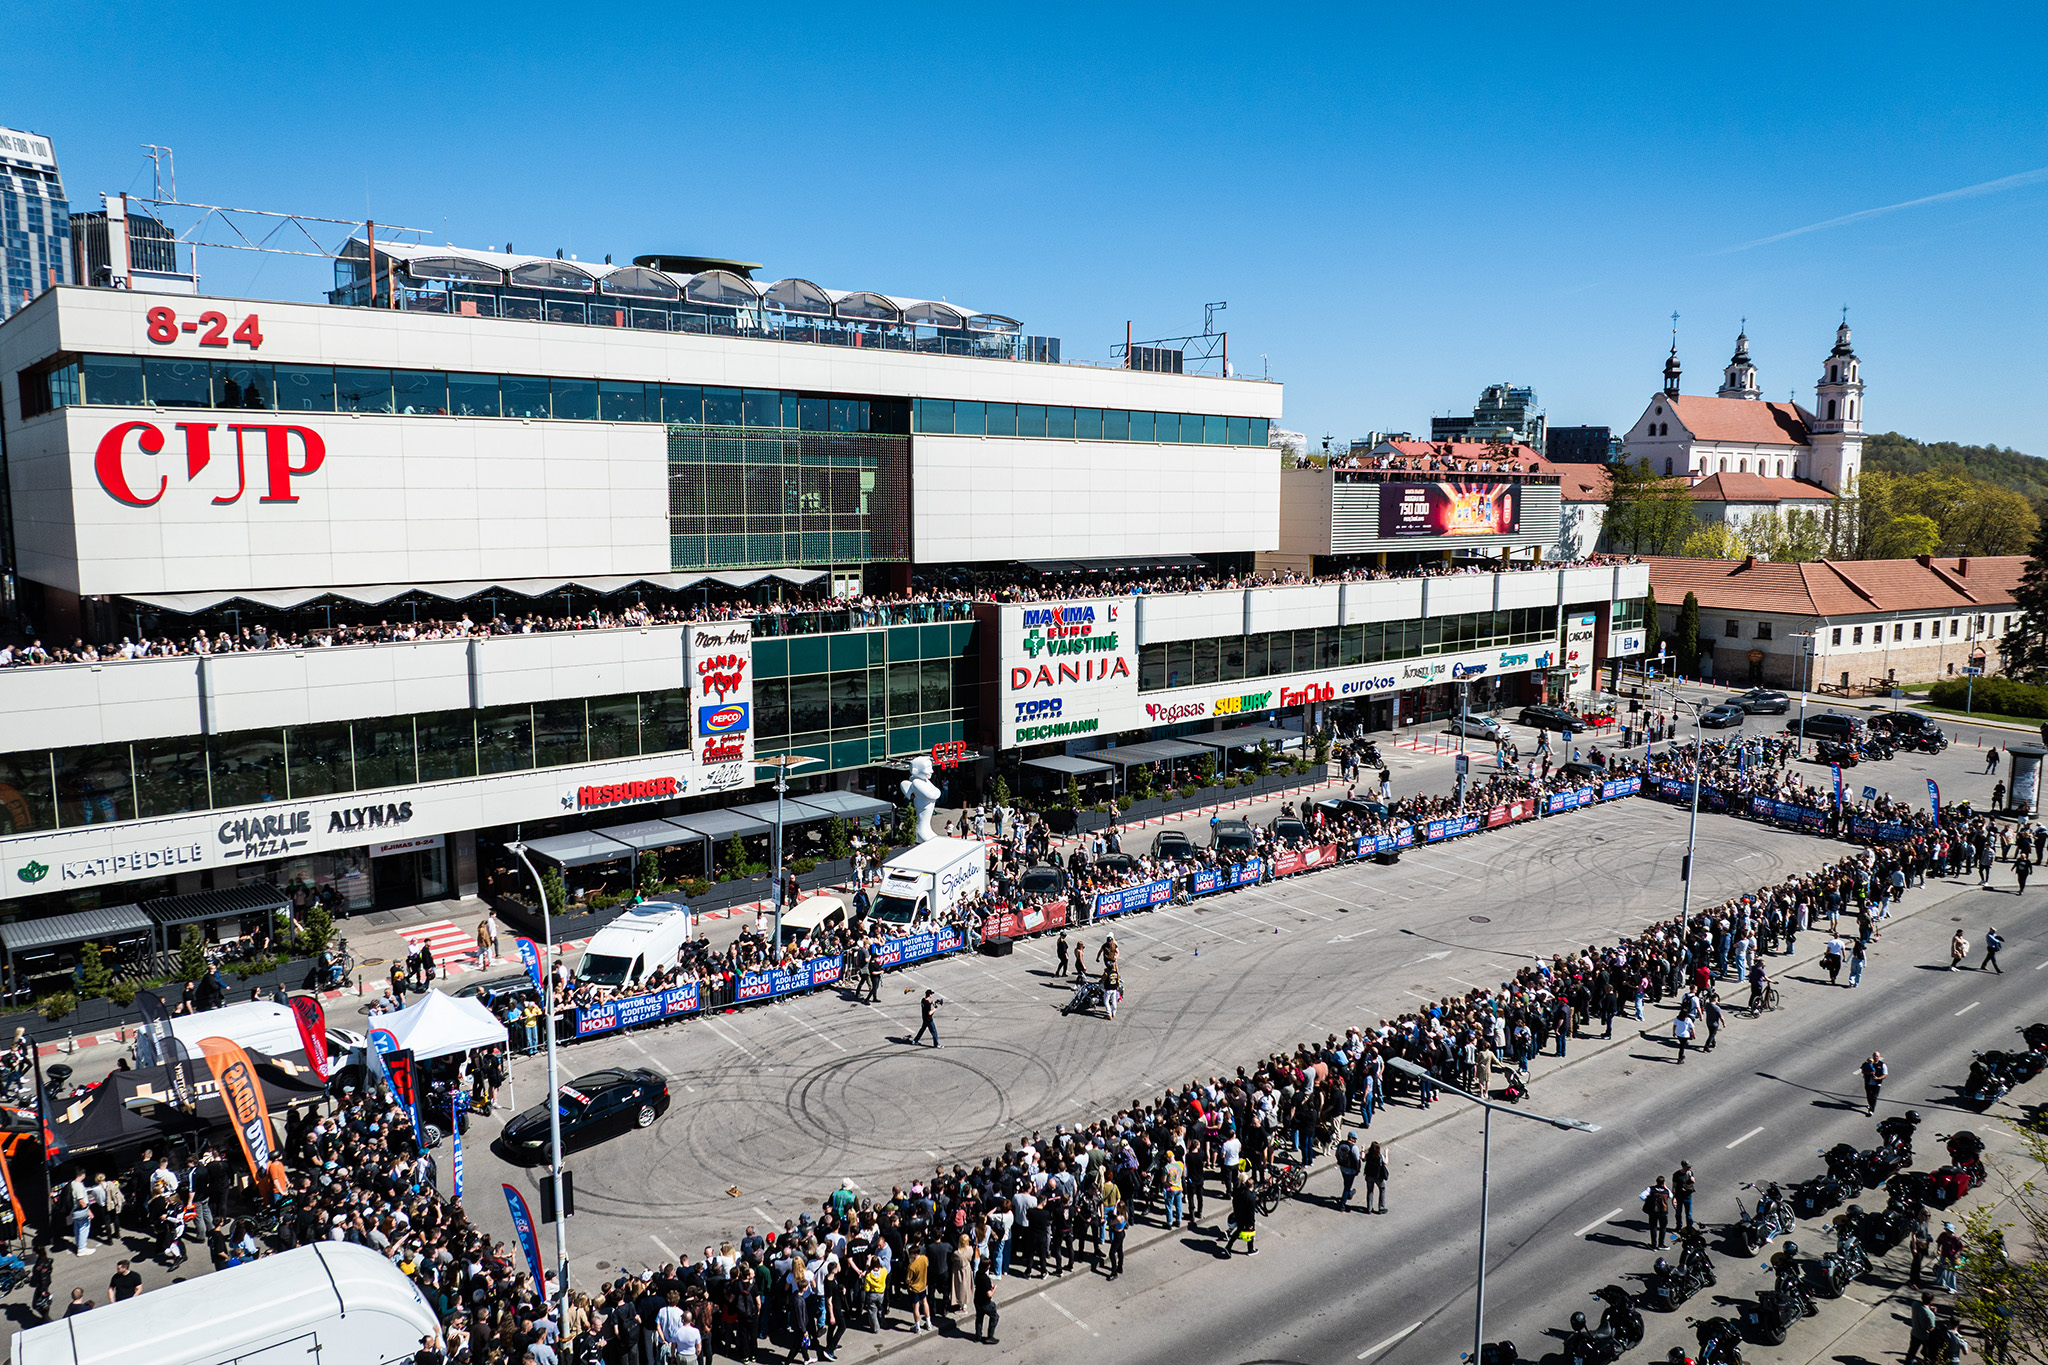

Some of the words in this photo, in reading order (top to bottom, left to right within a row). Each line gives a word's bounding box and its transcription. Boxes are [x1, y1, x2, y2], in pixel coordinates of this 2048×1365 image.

[12, 136, 29, 154] FOR
[29, 140, 47, 157] YOU
[147, 306, 264, 349] 8-24
[94, 423, 325, 505] CUP
[1024, 605, 1095, 628] MAXIMA
[695, 631, 723, 648] Mon
[724, 629, 750, 645] Ami
[1048, 625, 1092, 639] EURO
[698, 654, 747, 673] CANDY
[1011, 657, 1130, 690] DANIJA
[703, 672, 742, 702] POP
[1016, 698, 1062, 715] TOPO
[1213, 691, 1272, 716] SUBWAY
[713, 713, 738, 723] PEPCO
[1150, 702, 1205, 723] Pegasas
[1016, 718, 1099, 742] DEICHMANN
[703, 742, 744, 757] rieker
[577, 776, 677, 811] HESBURGER
[328, 802, 413, 833] ALYNAS
[218, 811, 311, 844] CHARLIE
[245, 839, 289, 859] PIZZA
[62, 843, 202, 881] KATPĖDĖLĖ
[1151, 882, 1170, 893] LIQUI
[1151, 890, 1170, 901] MOLY
[1101, 893, 1120, 904] LIQUI
[1100, 902, 1121, 913] MOLY
[902, 935, 922, 947] MOTOR
[904, 940, 934, 953] ADDITIVES
[904, 951, 917, 959] CAR
[918, 947, 933, 957] CARE
[814, 957, 840, 972] LIQUI
[740, 973, 769, 988] LIQUI
[815, 967, 841, 982] MOLY
[740, 983, 770, 998] MOLY
[776, 983, 790, 992] CAR
[791, 979, 809, 989] CARE
[618, 997, 646, 1011] MOTOR
[645, 994, 663, 1004] OILS
[666, 987, 696, 1003] LIQUI
[581, 1005, 614, 1021] LIQUI
[621, 1003, 661, 1017] ADDITIVES
[667, 997, 697, 1013] MOLY
[582, 1016, 616, 1032] MOLY
[622, 1014, 639, 1025] CAR
